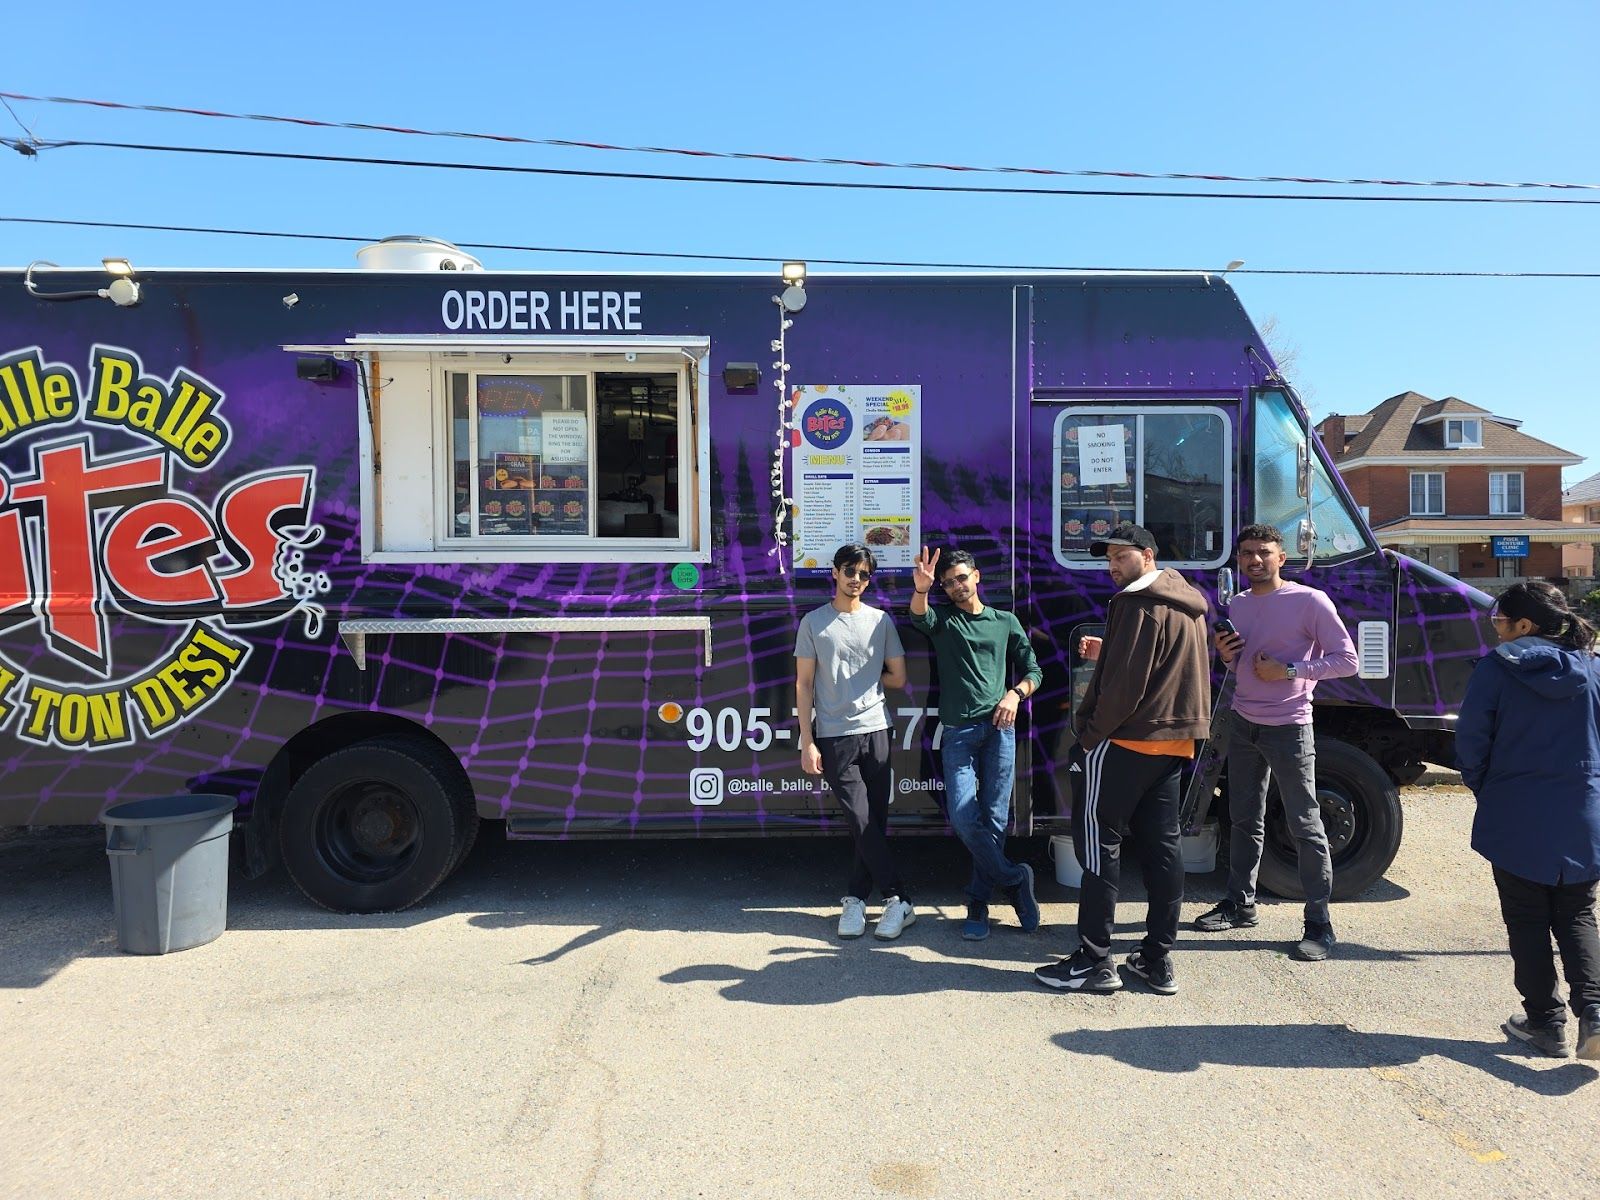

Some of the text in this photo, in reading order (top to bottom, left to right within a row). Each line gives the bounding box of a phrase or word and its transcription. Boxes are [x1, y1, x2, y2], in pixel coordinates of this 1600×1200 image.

[442, 290, 642, 330] ORDER HERE
[0, 356, 222, 463] alle Balle
[809, 454, 845, 465] MENU
[0, 444, 312, 656] ites
[28, 686, 125, 742] TON
[132, 627, 241, 728] DESI
[727, 778, 832, 795] @balle_balle_b
[898, 778, 947, 795] @balle
